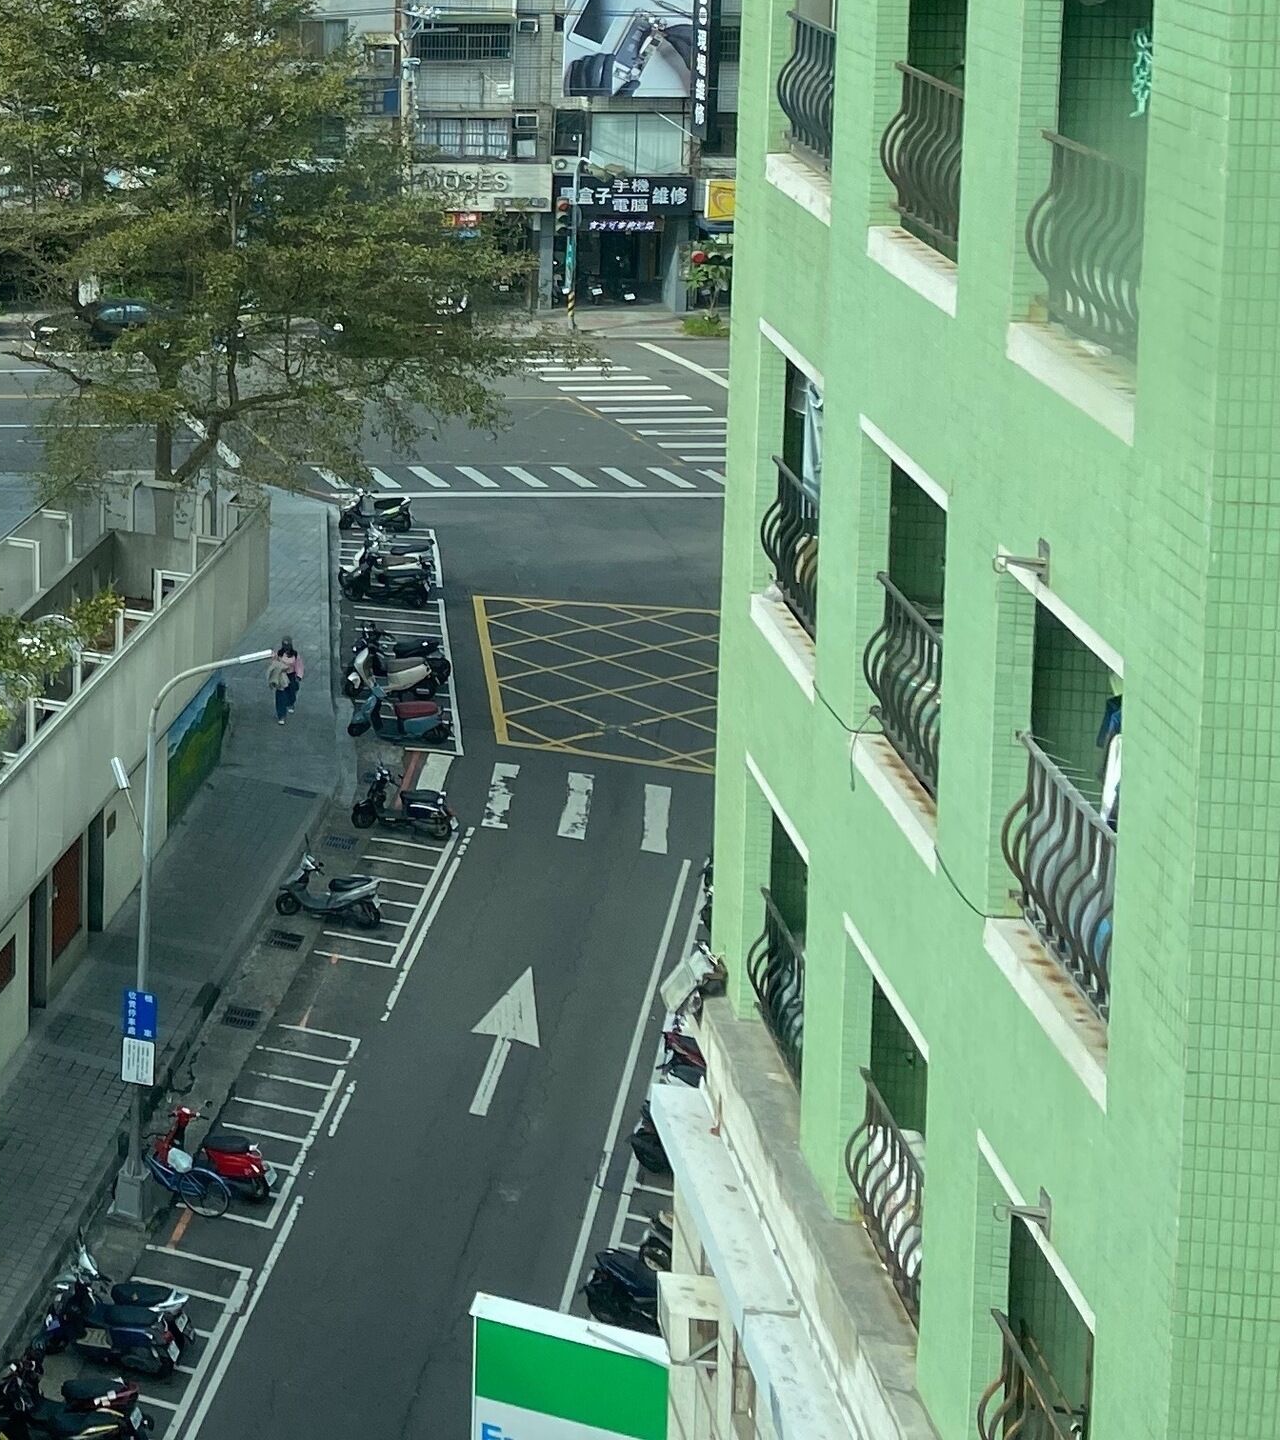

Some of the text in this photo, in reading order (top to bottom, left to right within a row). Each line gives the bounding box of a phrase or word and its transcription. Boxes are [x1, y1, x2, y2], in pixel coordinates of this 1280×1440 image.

[612, 178, 650, 193] 手機
[652, 186, 688, 205] 維修
[612, 198, 649, 212] 電腦
